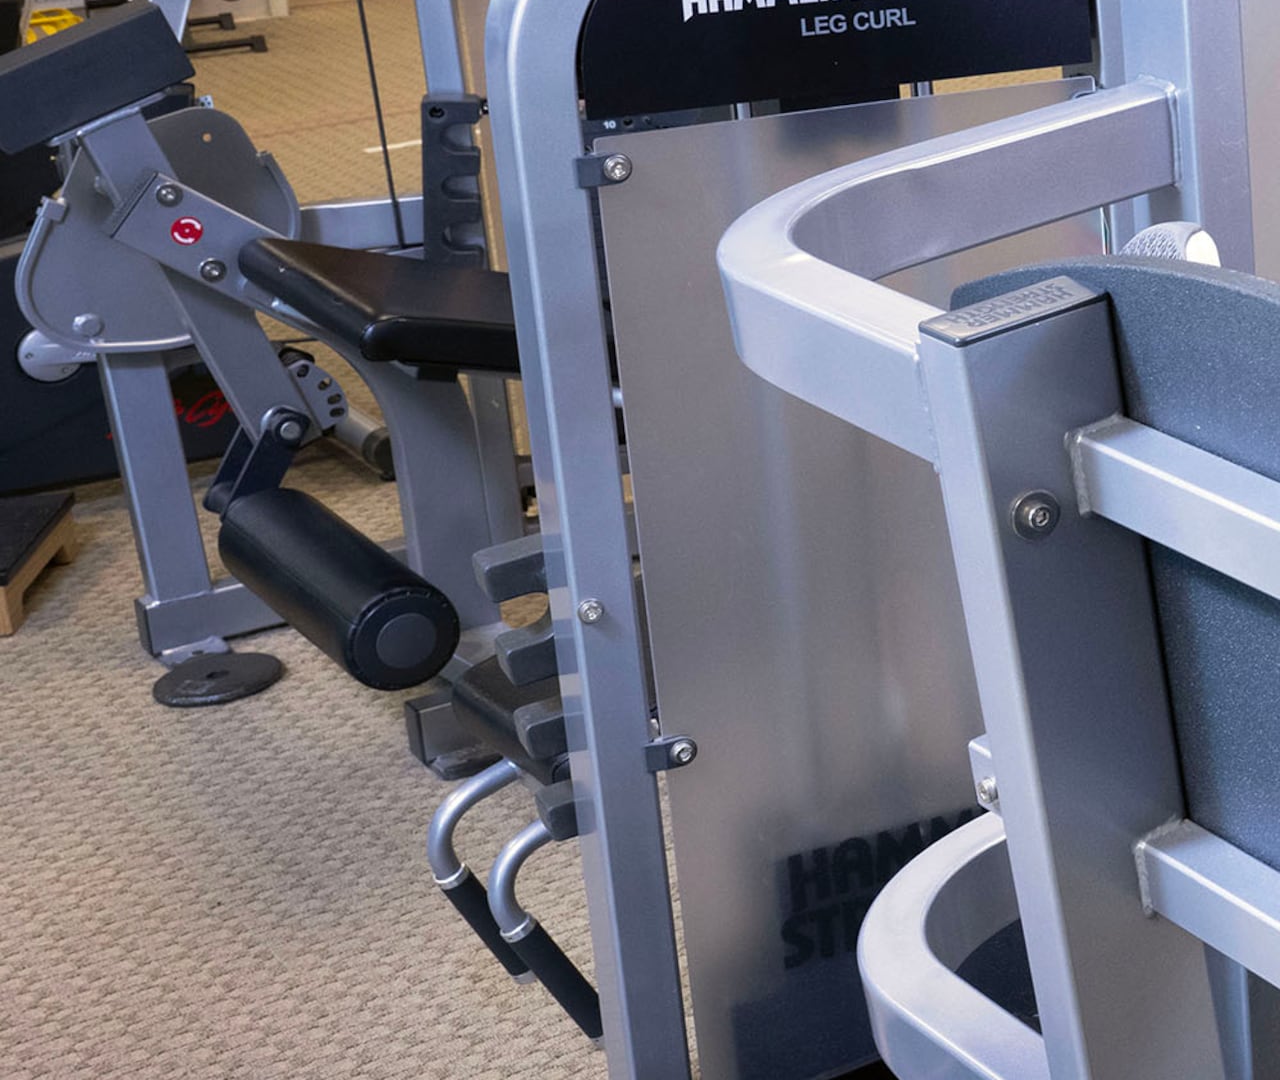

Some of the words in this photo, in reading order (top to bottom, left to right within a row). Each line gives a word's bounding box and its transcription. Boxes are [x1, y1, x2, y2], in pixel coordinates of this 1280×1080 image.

[800, 14, 847, 37] LEG
[853, 8, 916, 31] CURL
[603, 120, 617, 129] 10
[967, 286, 1074, 328] HAMMER
